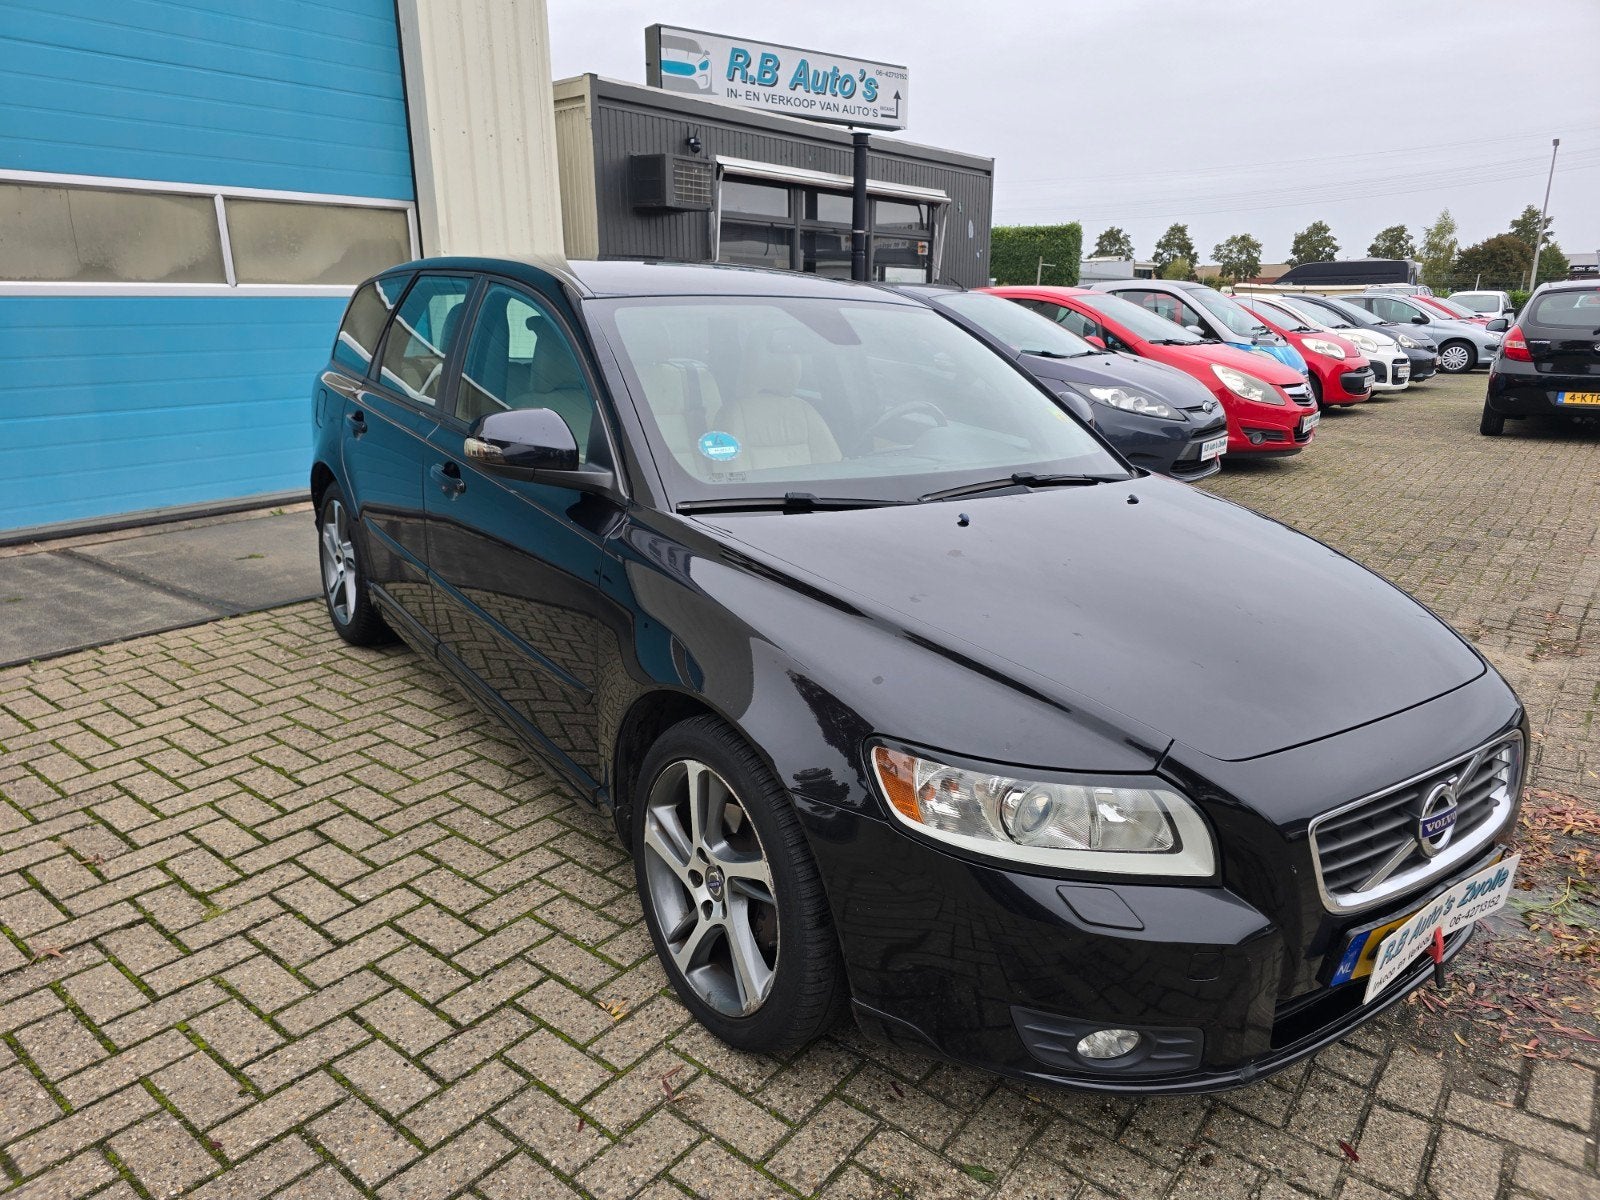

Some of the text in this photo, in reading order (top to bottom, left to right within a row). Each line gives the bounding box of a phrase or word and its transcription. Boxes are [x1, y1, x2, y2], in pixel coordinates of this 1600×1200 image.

[726, 47, 879, 103] R.B Auto's
[726, 87, 879, 118] IN- EN VERKOOP VAN AUTO'S
[1408, 894, 1455, 946] Auto's
[1457, 867, 1509, 908] Zwolle
[1449, 894, 1500, 927] 06-42713152
[1337, 962, 1351, 976] NL
